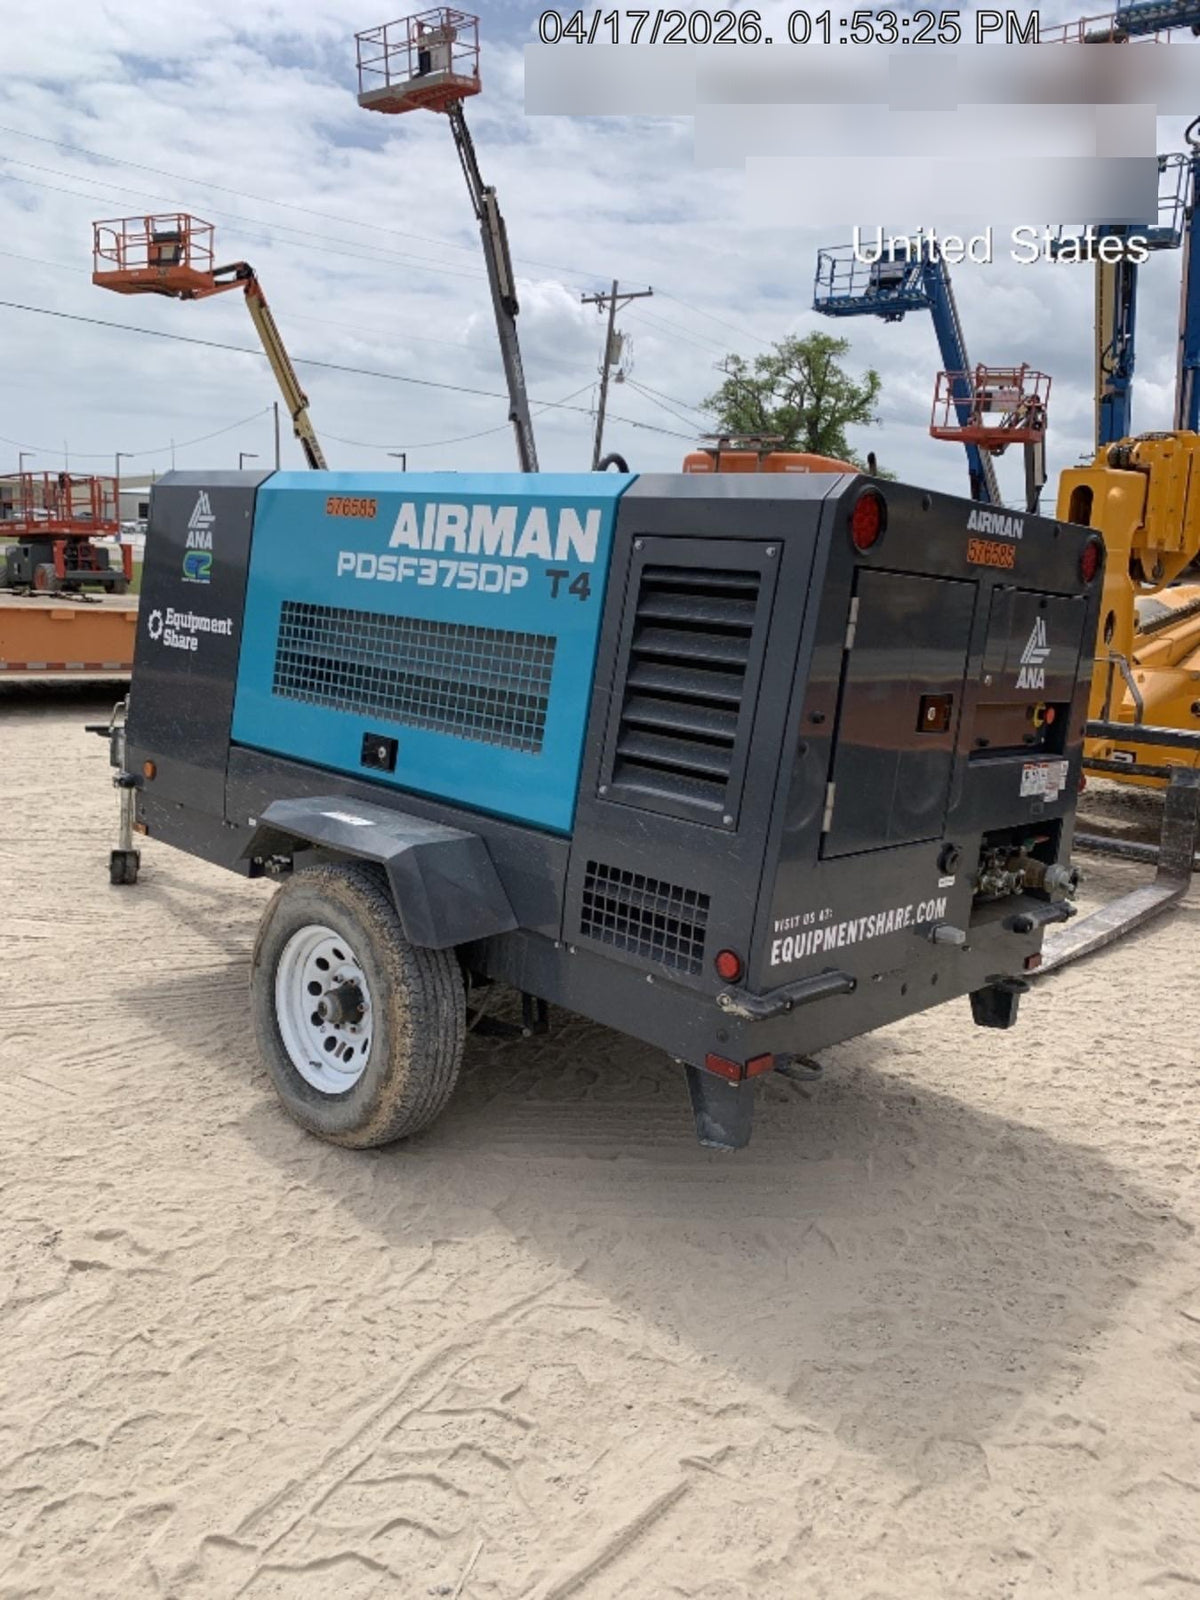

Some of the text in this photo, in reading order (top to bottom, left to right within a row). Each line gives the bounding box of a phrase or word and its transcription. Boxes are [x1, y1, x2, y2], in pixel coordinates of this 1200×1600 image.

[388, 502, 602, 563] AIRMAN
[967, 510, 1024, 539] AIRMAN
[185, 530, 213, 550] ANA
[337, 551, 591, 601] PDSF375DP T4
[165, 607, 233, 636] Equipment
[163, 629, 198, 651] Share
[1015, 666, 1045, 689] ANA
[770, 897, 947, 966] EQUIPMENTSHARE.COM
[774, 915, 801, 932] VISIT
